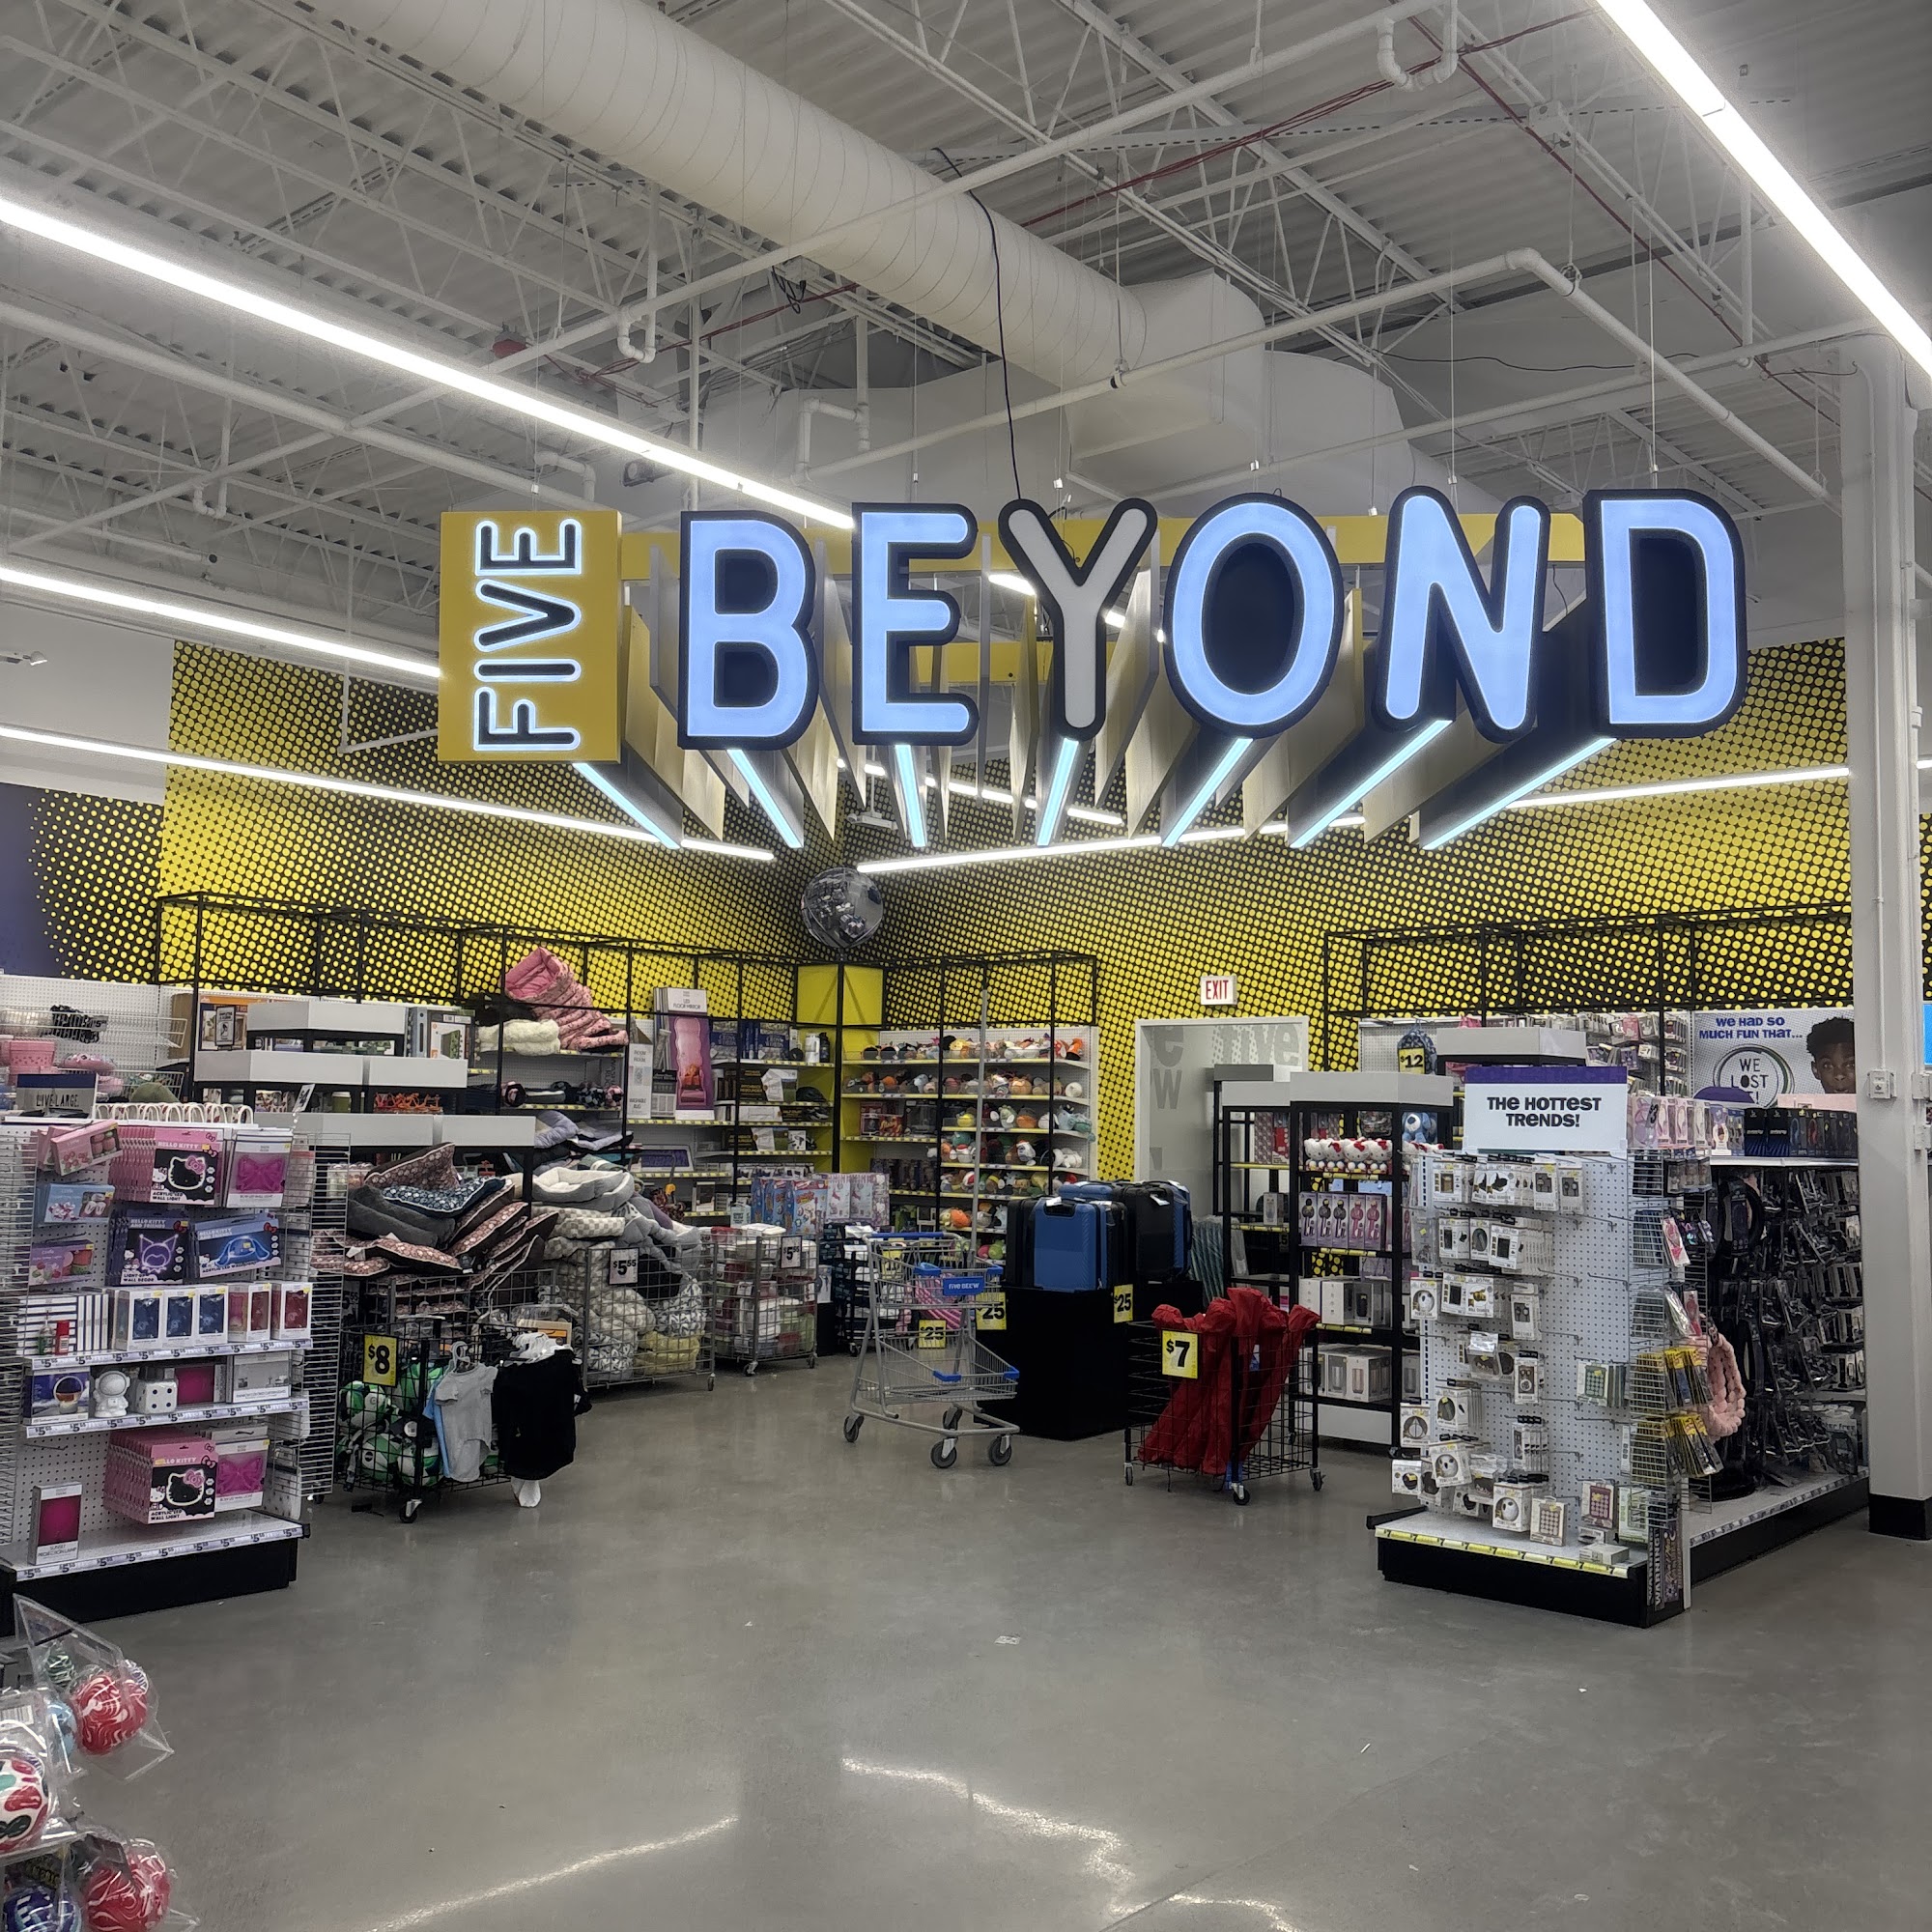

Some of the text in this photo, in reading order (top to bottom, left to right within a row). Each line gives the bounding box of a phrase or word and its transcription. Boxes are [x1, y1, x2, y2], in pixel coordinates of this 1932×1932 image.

[680, 488, 1745, 750] BEYOND
[473, 518, 582, 752] FIVE
[1206, 980, 1229, 1000] EXIT
[1767, 1016, 1785, 1026] SO
[1699, 1030, 1733, 1039] MUCH
[1737, 1029, 1759, 1038] FUN
[1400, 1055, 1423, 1068] $12
[1740, 1058, 1761, 1071] WE
[1731, 1075, 1769, 1089] LOST
[1114, 1293, 1132, 1313] $25
[368, 1343, 390, 1375] $8
[1166, 1340, 1190, 1368] $7
